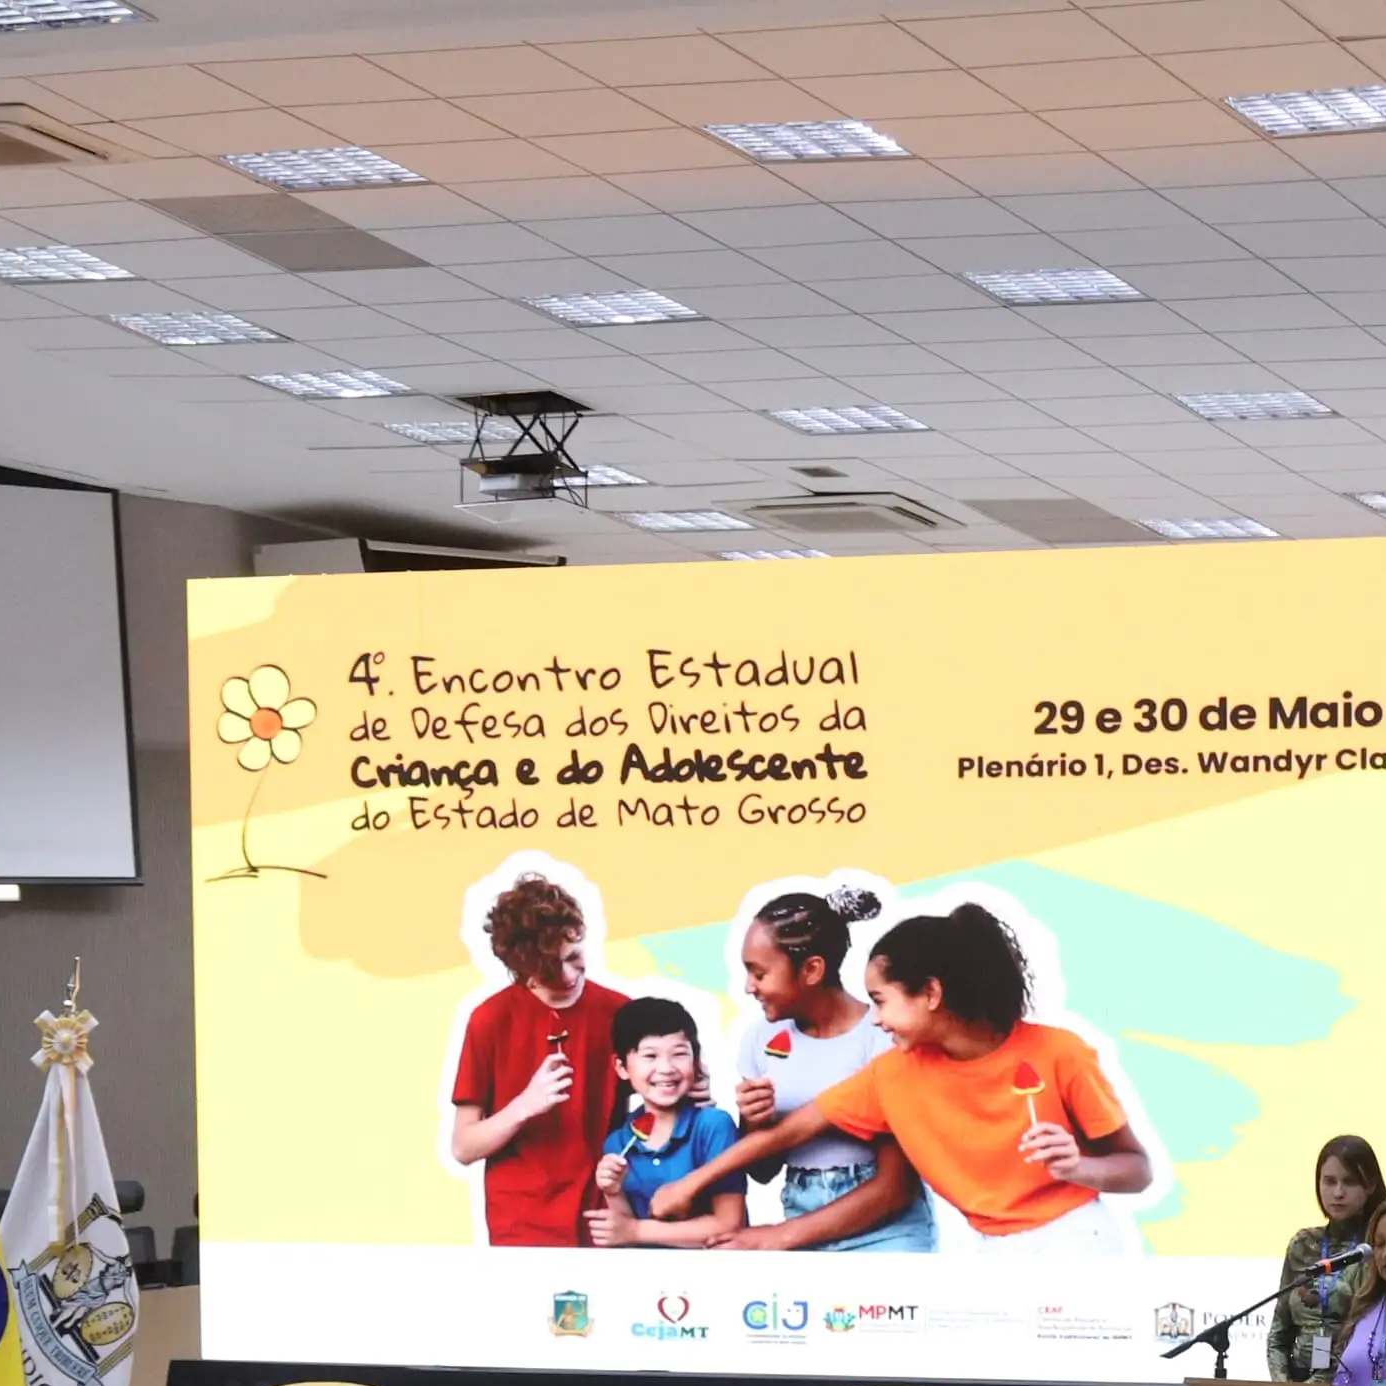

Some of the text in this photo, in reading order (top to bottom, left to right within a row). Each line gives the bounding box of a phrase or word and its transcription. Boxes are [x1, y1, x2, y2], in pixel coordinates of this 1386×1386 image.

[409, 655, 622, 696] Encontro
[645, 648, 859, 690] Estadual
[348, 698, 867, 745] de Defesa dos Direitos da
[1033, 699, 1085, 736] 29
[1094, 707, 1123, 735] e
[1132, 697, 1188, 734] 30
[1198, 695, 1258, 732] de
[1268, 689, 1384, 731] Maio
[350, 742, 869, 801] Criança e do Adolescente
[957, 751, 1088, 780] Plenário
[1093, 753, 1114, 780] 1,
[1121, 753, 1189, 776] Des.
[1196, 748, 1328, 781] Wandyr
[350, 792, 867, 832] do Estado de Mato Grosso
[859, 1304, 919, 1321] MPMT
